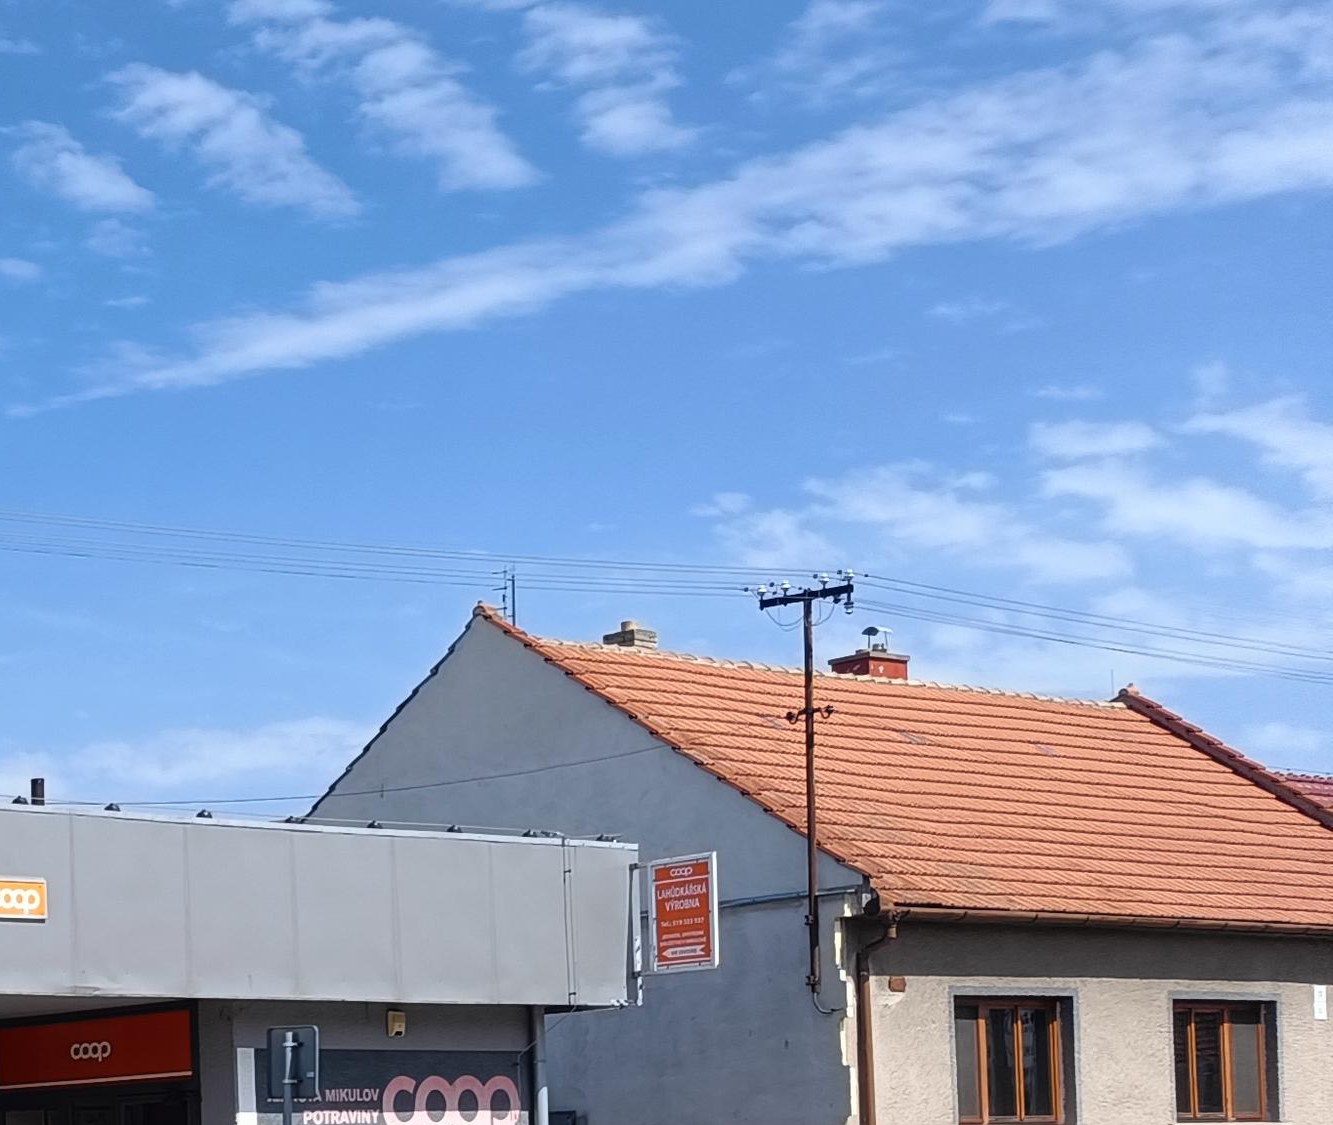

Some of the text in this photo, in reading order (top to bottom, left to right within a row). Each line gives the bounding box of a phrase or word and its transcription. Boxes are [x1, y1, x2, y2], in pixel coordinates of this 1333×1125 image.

[670, 867, 693, 877] coop
[665, 897, 700, 912] VÝROBNA
[70, 1041, 111, 1062] coop
[325, 1088, 380, 1103] MIKULOV
[303, 1109, 380, 1125] POTRAVINY
